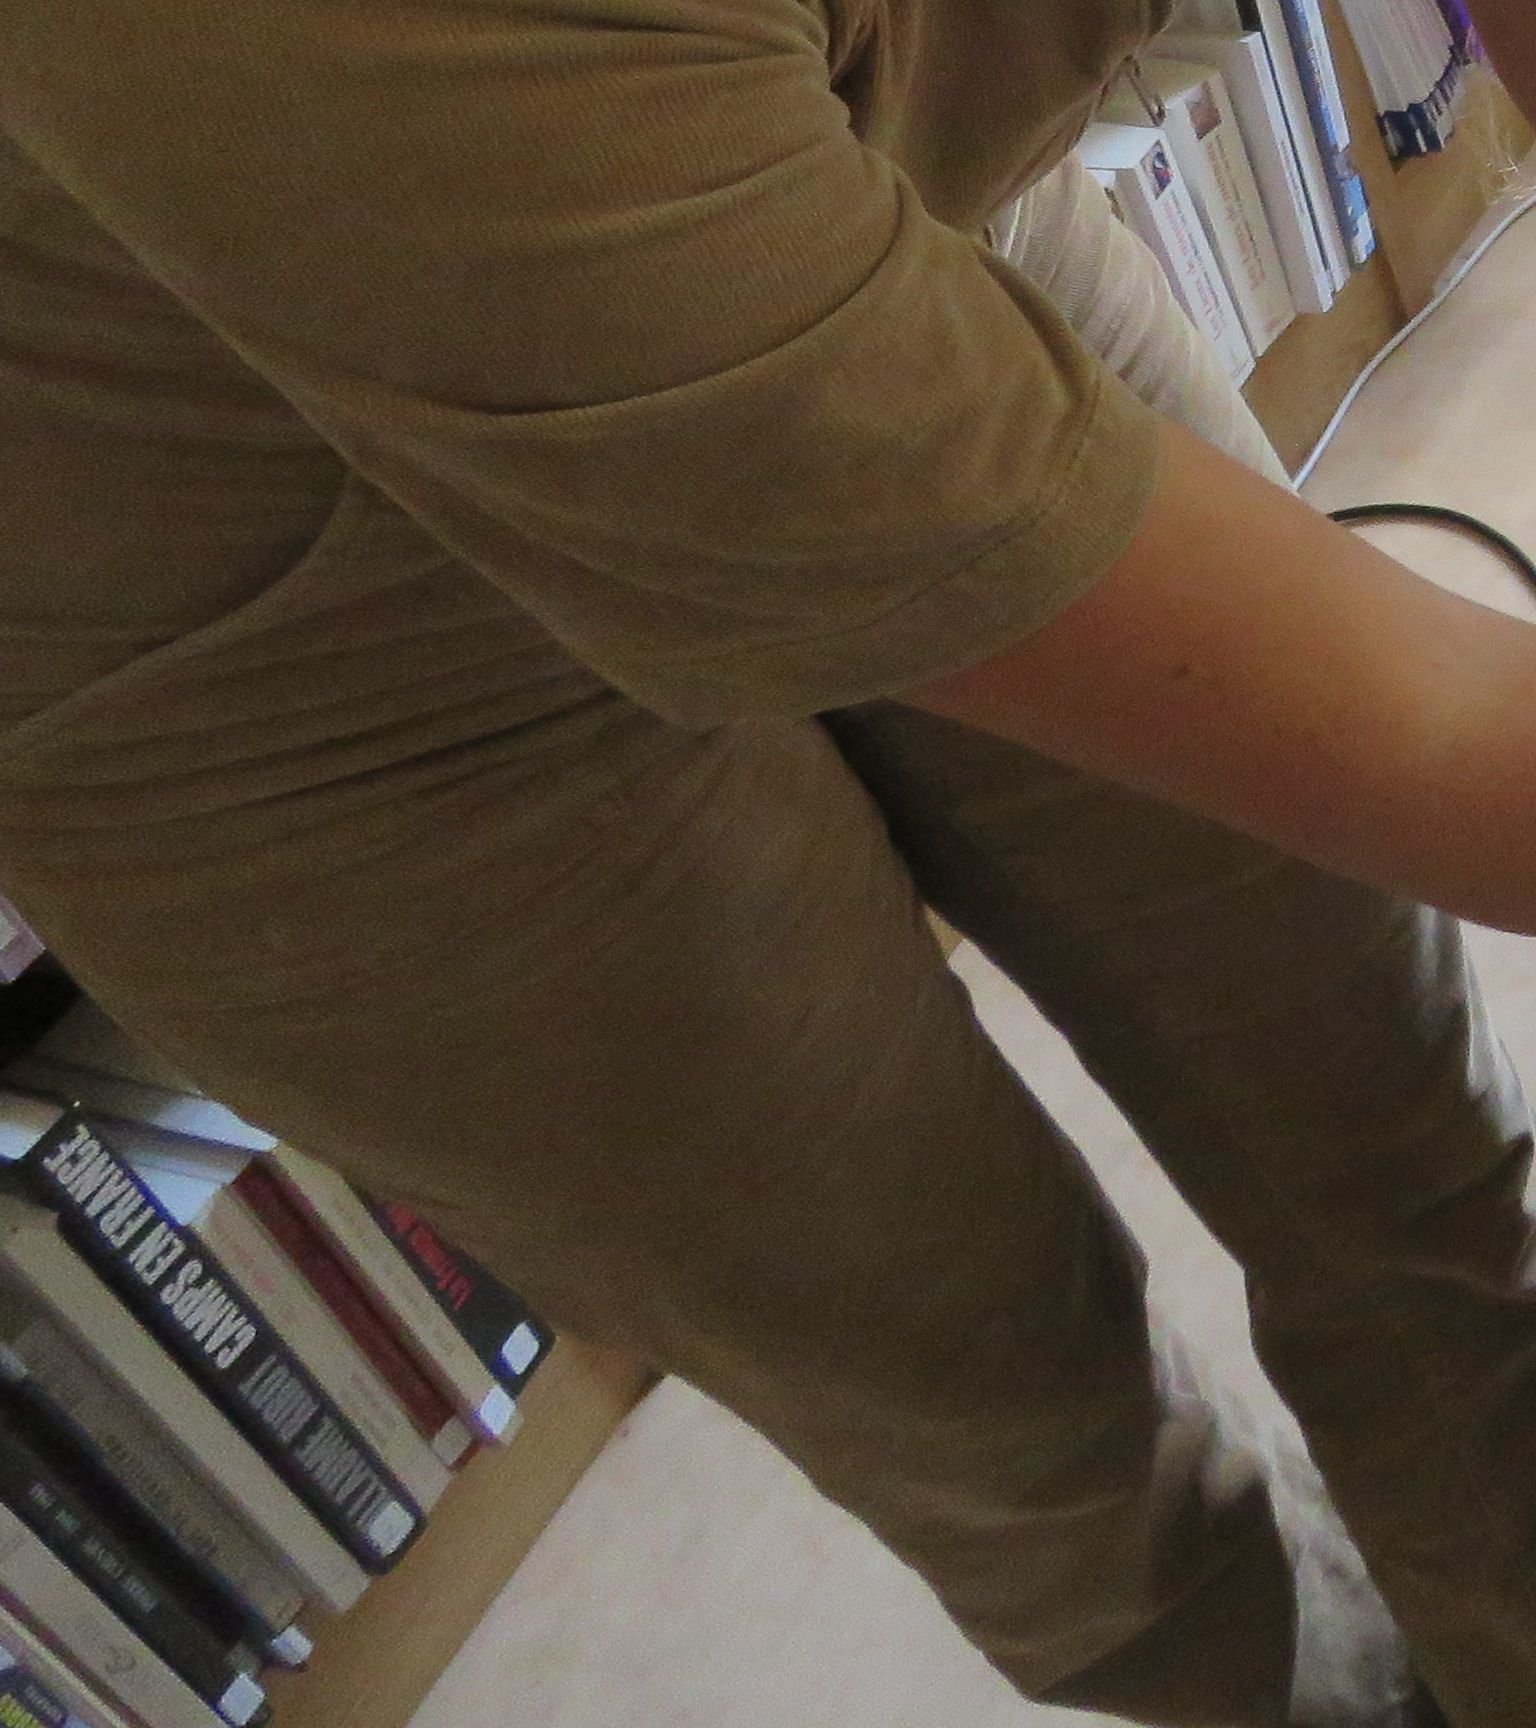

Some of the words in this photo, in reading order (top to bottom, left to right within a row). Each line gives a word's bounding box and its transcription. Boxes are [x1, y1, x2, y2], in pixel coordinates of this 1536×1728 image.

[41, 1123, 156, 1250] FRANCE
[129, 1221, 186, 1286] EN
[158, 1258, 258, 1370] CAMPS
